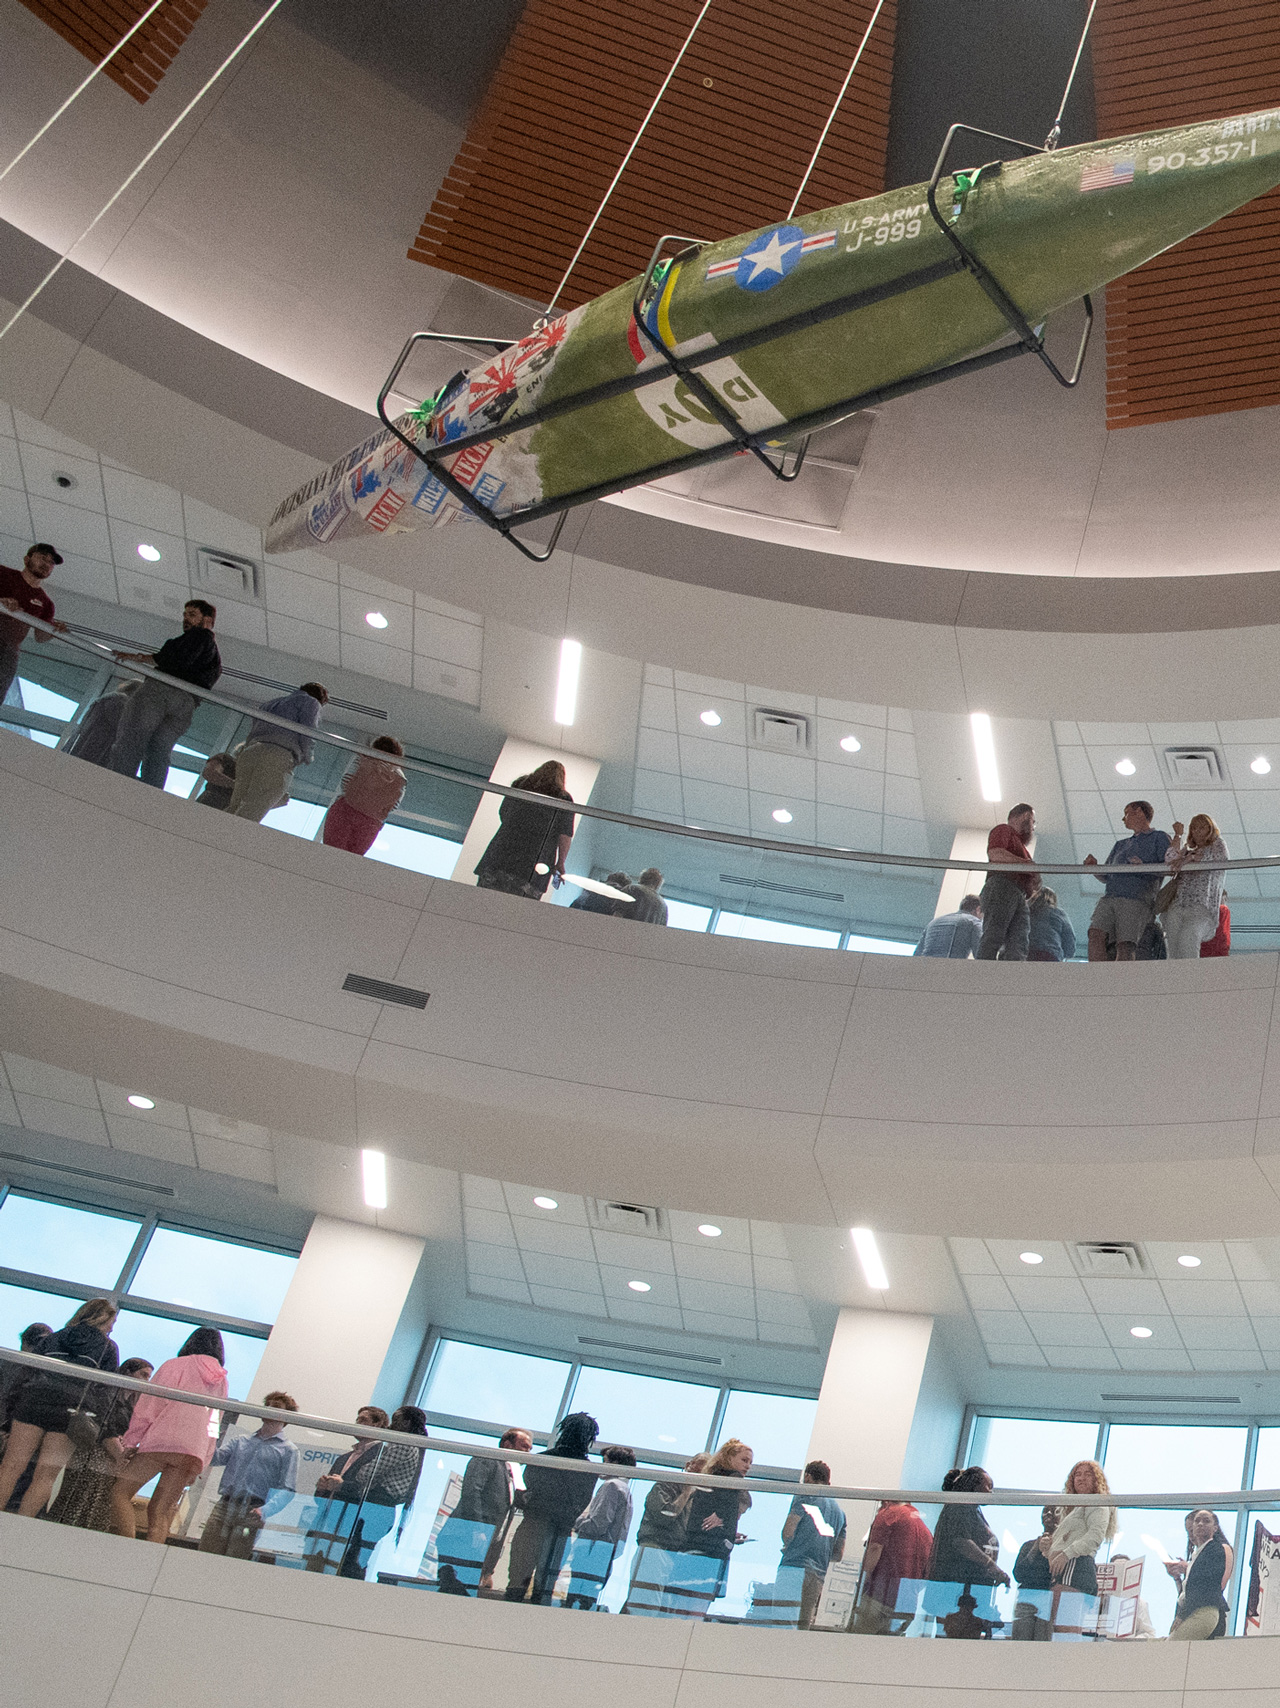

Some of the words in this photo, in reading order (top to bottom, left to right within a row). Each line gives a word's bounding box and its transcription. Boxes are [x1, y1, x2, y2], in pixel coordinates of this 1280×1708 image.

[1147, 138, 1257, 175] 90-357-1
[845, 219, 922, 252] J-999
[452, 442, 491, 485] TECH
[367, 491, 404, 531] TECH
[303, 1449, 341, 1465] SPRI
